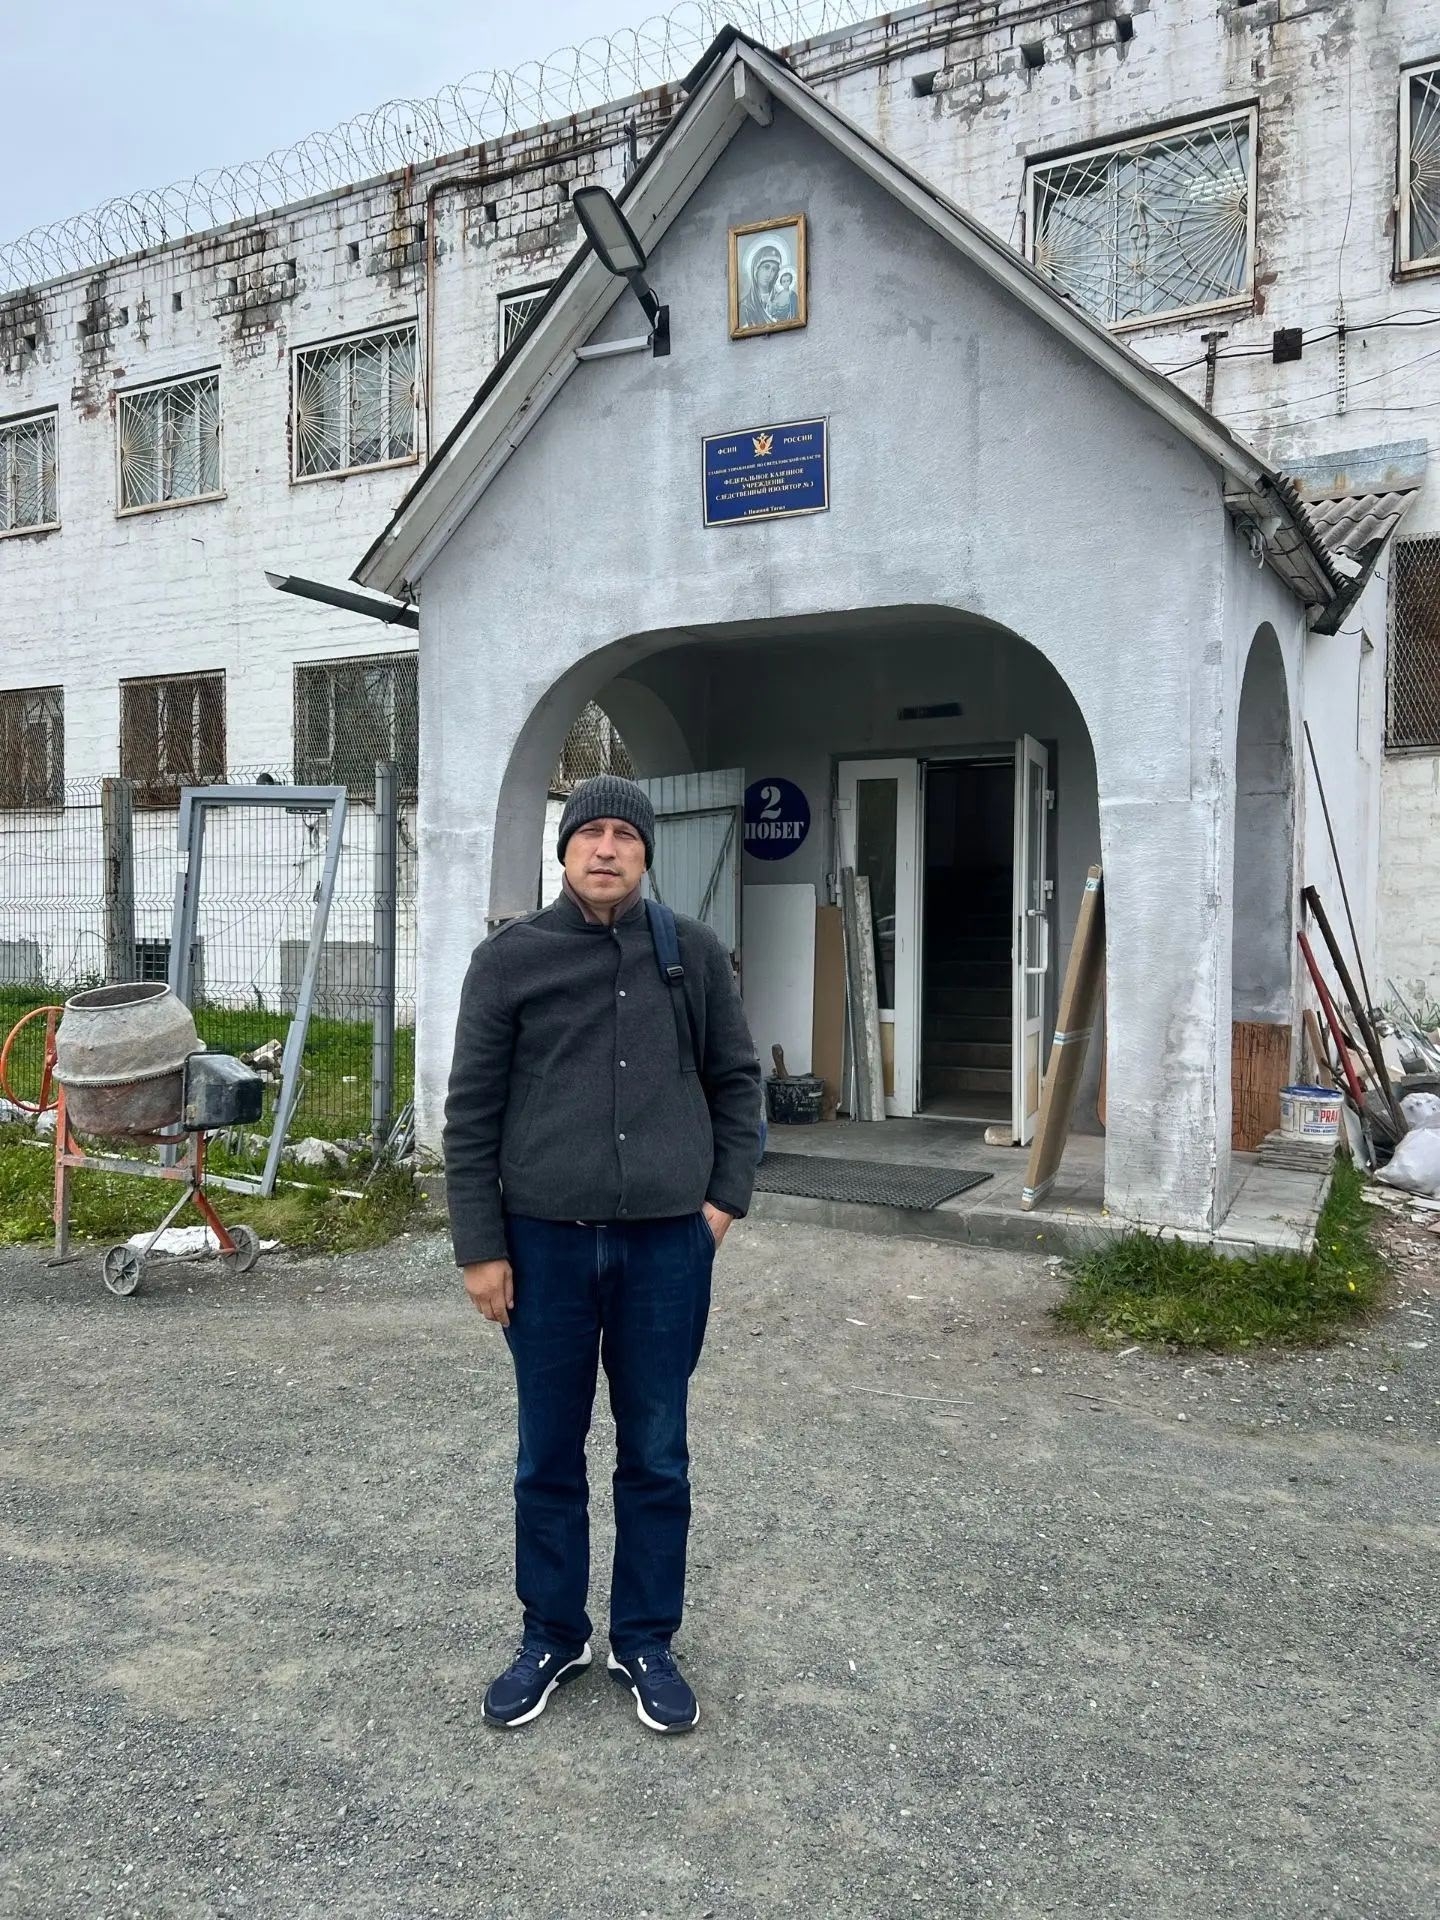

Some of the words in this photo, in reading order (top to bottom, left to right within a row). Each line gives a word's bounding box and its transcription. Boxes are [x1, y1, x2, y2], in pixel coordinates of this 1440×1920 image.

[717, 446, 737, 455] ФСИН
[783, 434, 813, 445] РОССИИ
[724, 473, 769, 486] ФЕДЕРАЛЬНОЕ
[770, 468, 804, 478] КАЗЕННОЕ
[742, 478, 785, 490] УЧРЕЖДЕНИЕ
[716, 487, 767, 501] СЛЕДСТВЕННЫЙ
[768, 482, 801, 493] ИЗОЛЯТОР
[749, 506, 769, 515] Нижний
[770, 505, 786, 513] Тагил
[760, 785, 782, 820] 2
[744, 821, 805, 840] ПОБЕГ
